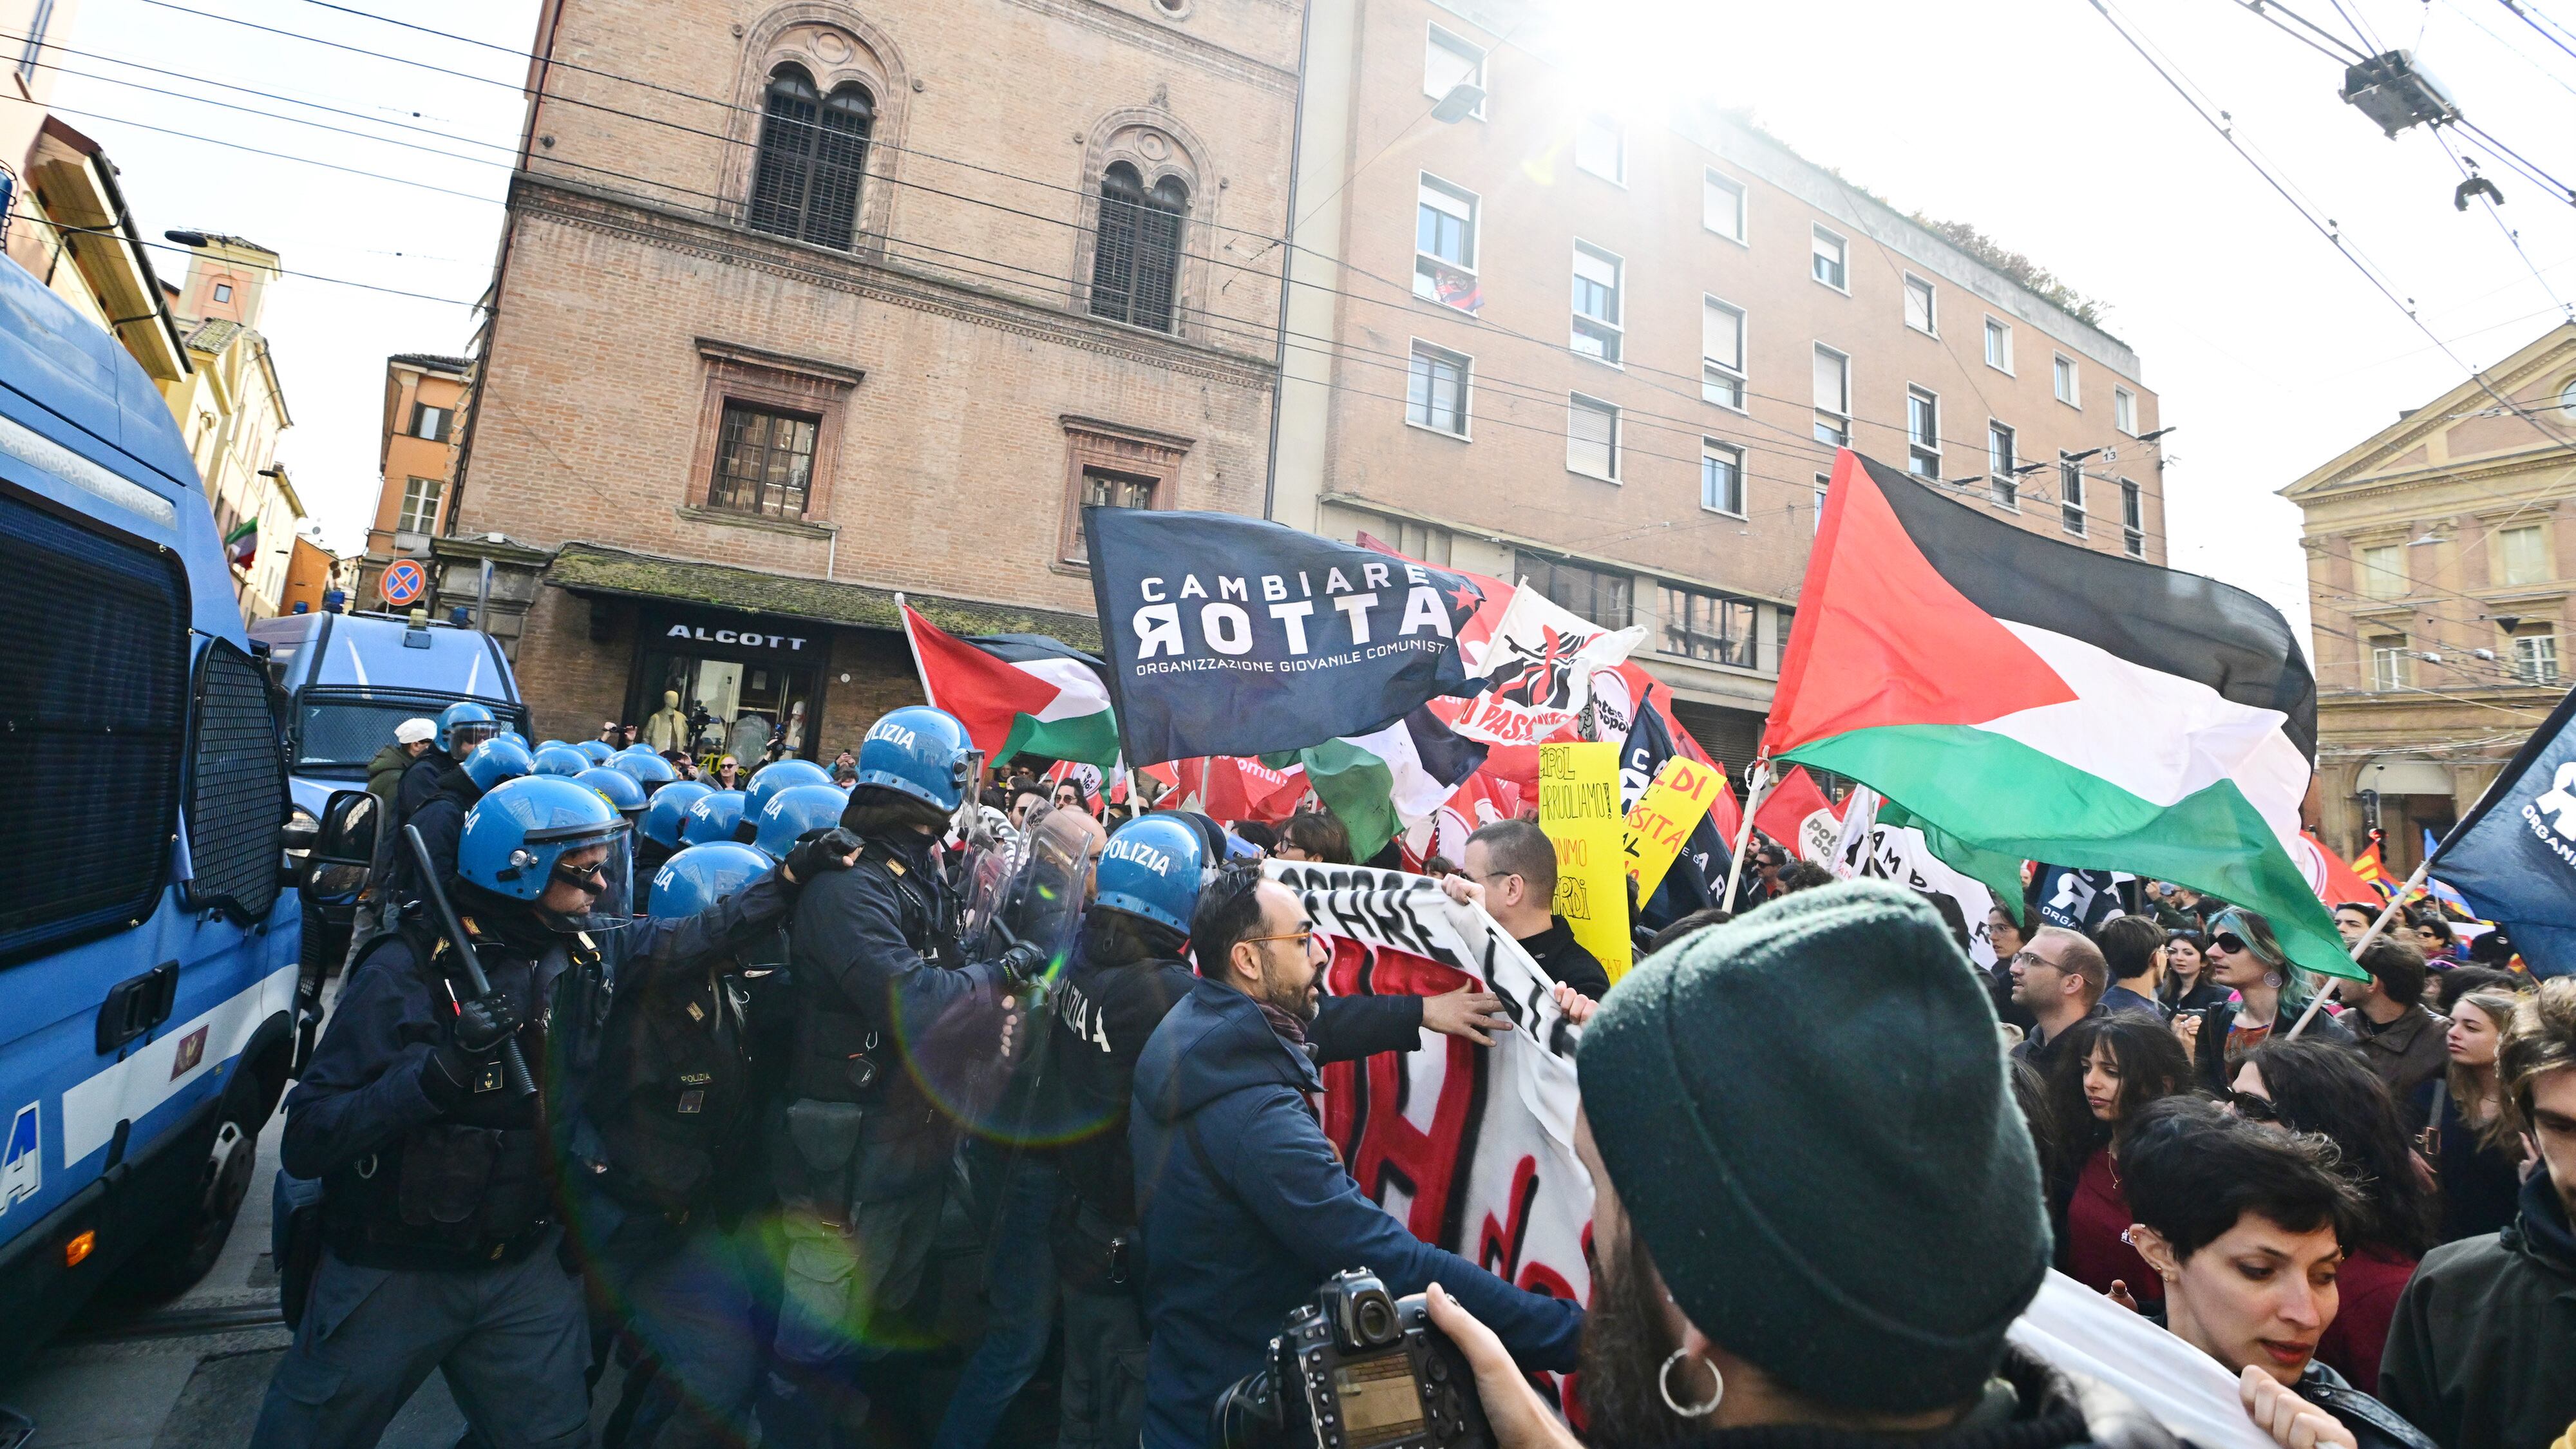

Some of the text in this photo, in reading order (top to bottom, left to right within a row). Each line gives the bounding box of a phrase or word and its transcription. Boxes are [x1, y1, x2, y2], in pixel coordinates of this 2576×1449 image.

[1141, 562, 1430, 603] CAMBIARE
[667, 624, 807, 651] ALCOTT
[1133, 586, 1454, 659] ROTTA
[1136, 658, 1274, 676] ORGANIZZAZIONE
[1280, 650, 1361, 672] GIOVANILE
[864, 723, 916, 750] OLIZIA
[1541, 782, 1612, 820] ARRUOLIAMO!
[1669, 766, 1708, 801] DI
[1622, 804, 1686, 855] RSITA
[1099, 839, 1170, 877] POLIZIA
[681, 1072, 712, 1083] POLIZIA
